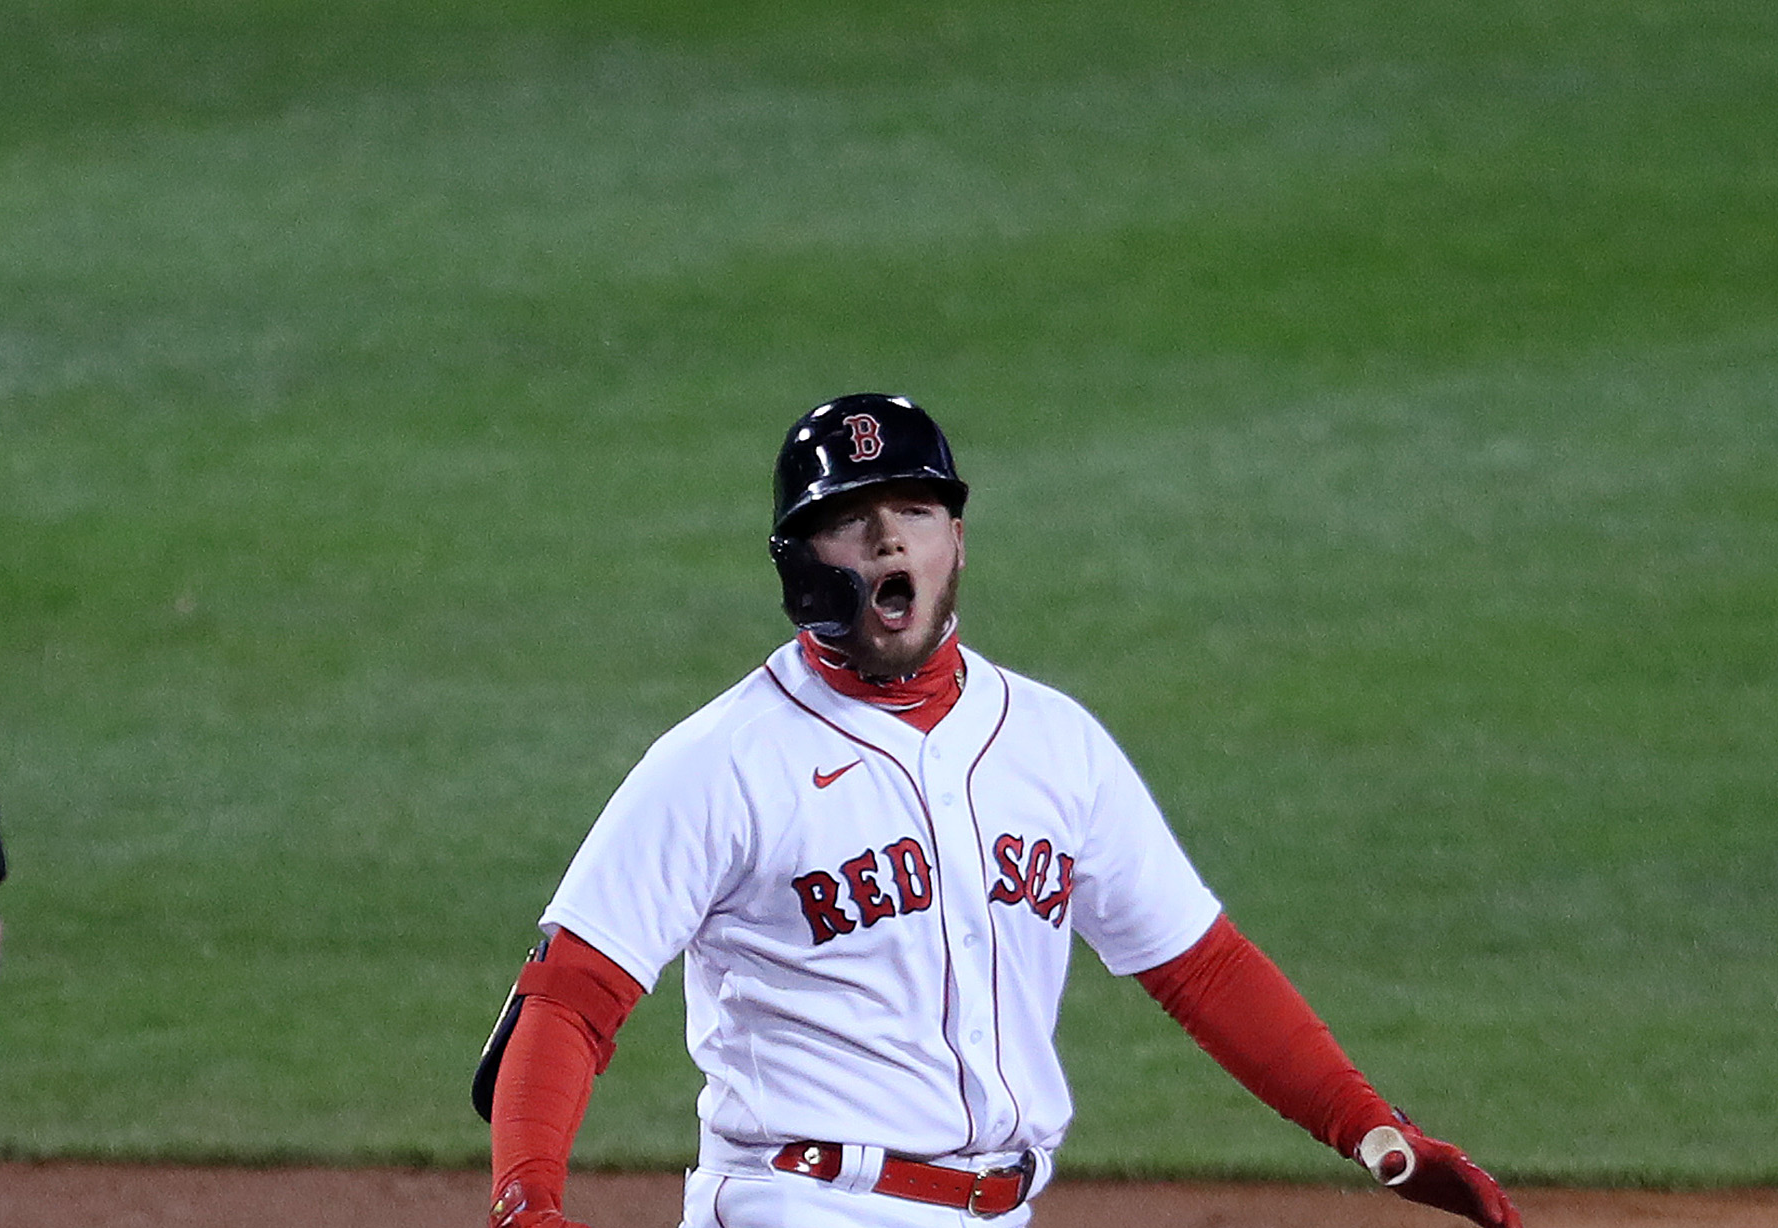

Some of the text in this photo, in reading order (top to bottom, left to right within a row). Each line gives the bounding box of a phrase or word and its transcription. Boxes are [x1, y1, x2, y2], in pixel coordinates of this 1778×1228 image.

[843, 413, 884, 462] B
[791, 833, 1075, 945] RED SOX
